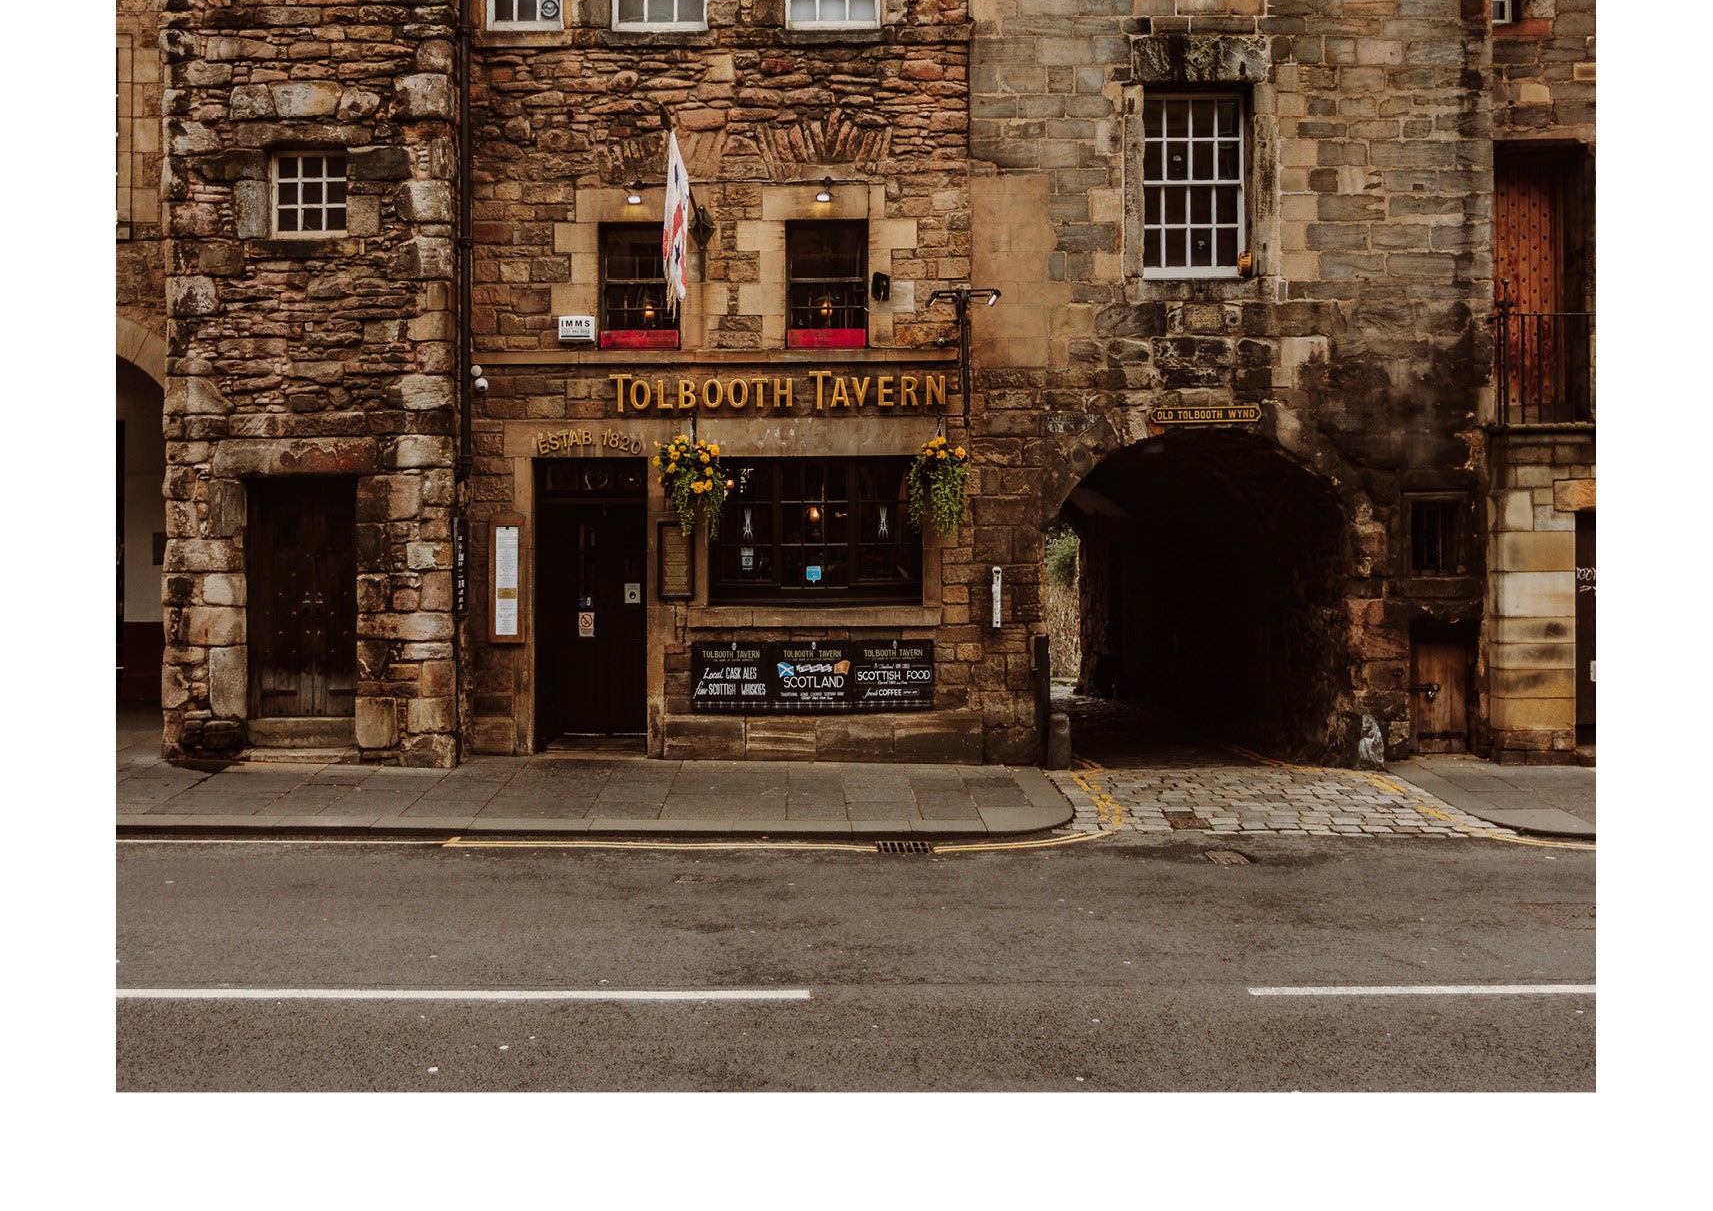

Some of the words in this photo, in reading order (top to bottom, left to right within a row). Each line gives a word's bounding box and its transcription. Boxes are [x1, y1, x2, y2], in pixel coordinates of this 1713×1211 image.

[561, 320, 590, 328] IMMS
[609, 373, 793, 413] TOLBOOTH
[808, 370, 946, 410] TAVERN
[1157, 411, 1173, 420] OLD
[1178, 410, 1223, 420] TOLBOOTH
[1228, 409, 1255, 419] WYND
[537, 430, 596, 455] ESTAB.
[602, 430, 642, 455] 1820
[702, 650, 734, 659] TOLBOOTH
[736, 650, 760, 659] TAVERN
[783, 650, 814, 658] TOLBOOTH
[818, 650, 842, 658] TAVERN
[864, 649, 897, 657] TOLBOOTH
[898, 648, 923, 657] TAVERN
[703, 667, 724, 680] Local
[725, 667, 742, 680] CASK
[742, 667, 757, 680] ALES
[857, 670, 901, 681] SCOTTISH
[906, 670, 931, 680] FOOD
[783, 676, 845, 688] SCOTLAND
[708, 683, 737, 695] SCOTTISH
[740, 683, 766, 696] WHISKIES
[878, 688, 902, 696] COFFEE
